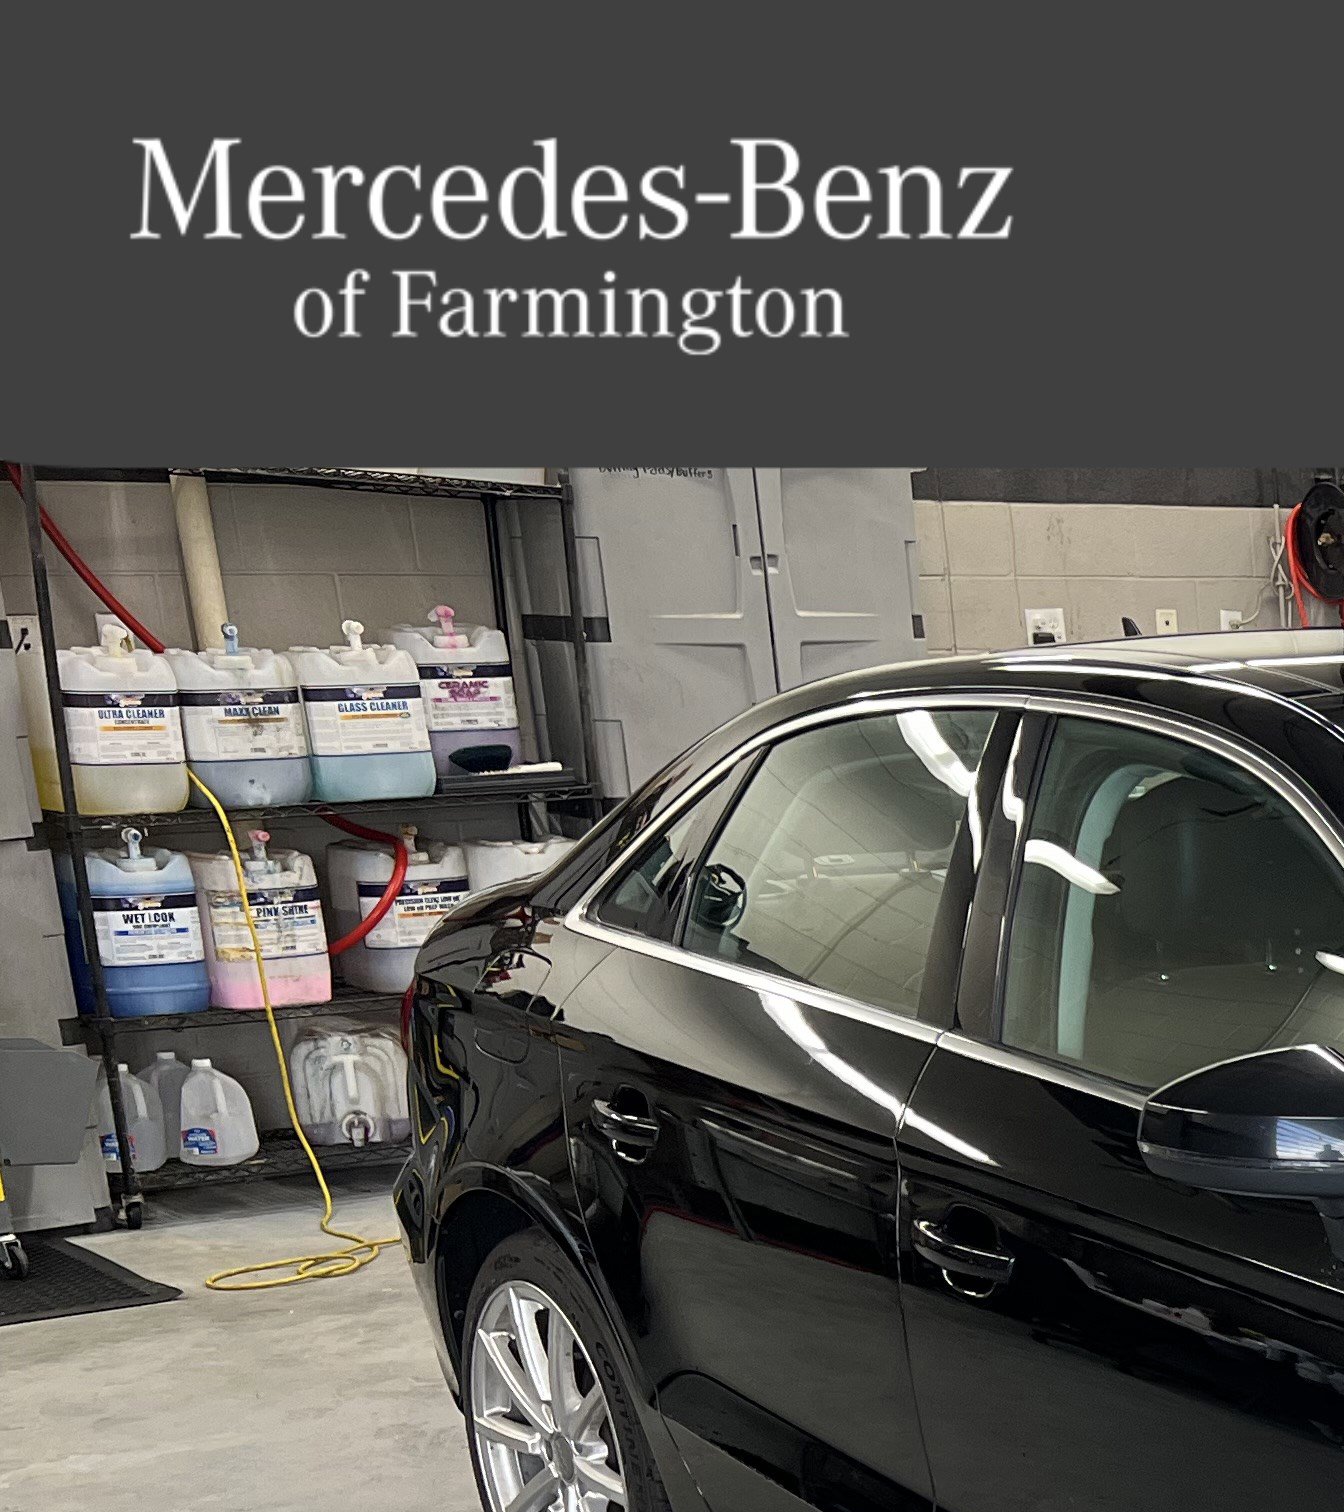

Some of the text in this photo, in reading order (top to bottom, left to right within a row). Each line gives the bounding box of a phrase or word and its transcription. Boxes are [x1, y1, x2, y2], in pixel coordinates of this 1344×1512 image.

[438, 680, 489, 689] CERAMIC
[251, 706, 280, 717] CLEAN
[338, 700, 409, 713] GLASS CLEANER
[98, 708, 165, 719] ULTRA CLEANER
[256, 904, 309, 917] PINK SHINE
[122, 913, 146, 924] WET
